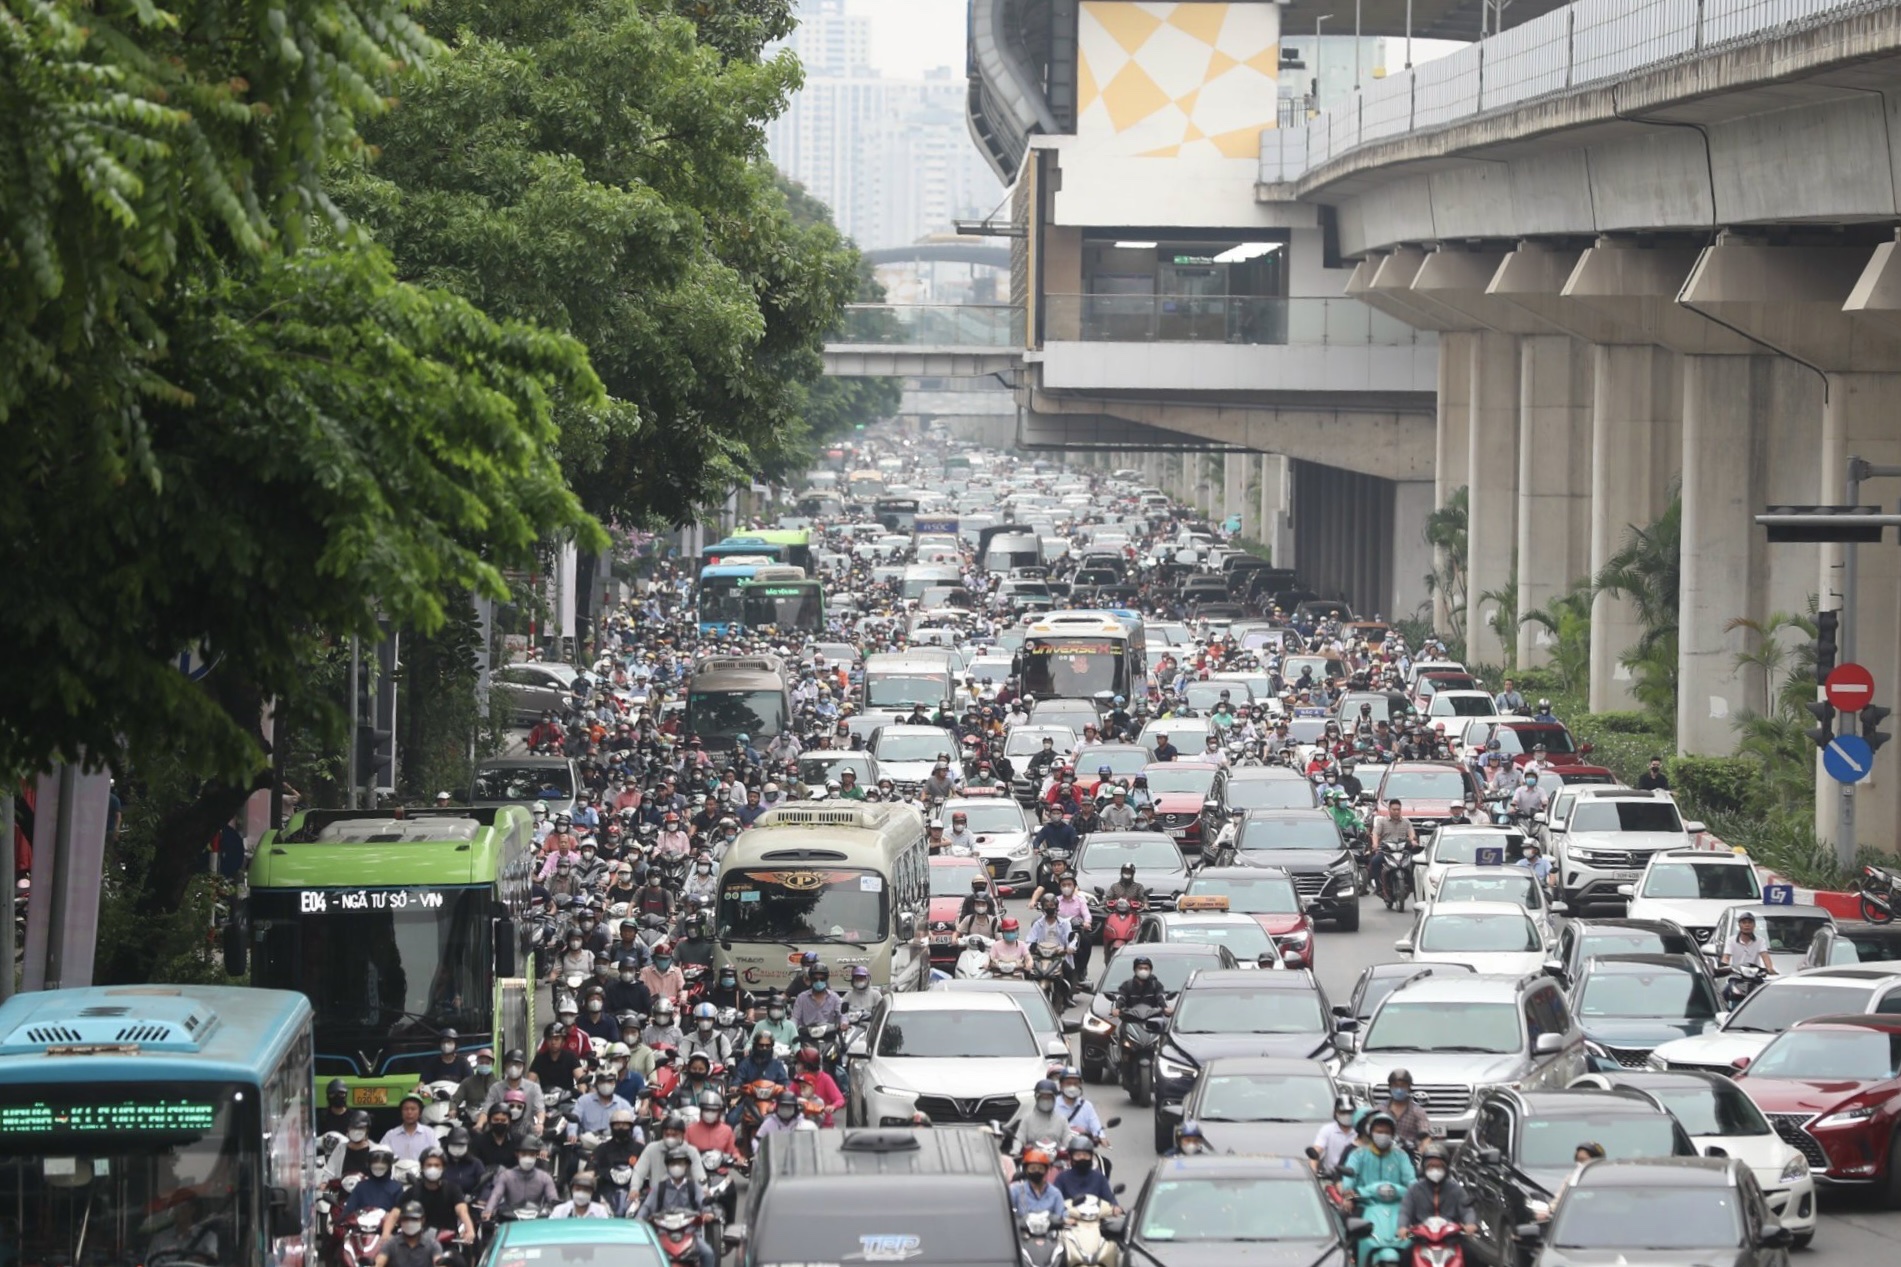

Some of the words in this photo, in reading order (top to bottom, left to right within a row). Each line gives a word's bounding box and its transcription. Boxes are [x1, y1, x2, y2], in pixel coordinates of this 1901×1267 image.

[300, 890, 327, 913] E04
[341, 890, 369, 909] NGÃ
[1771, 887, 1787, 903] G7
